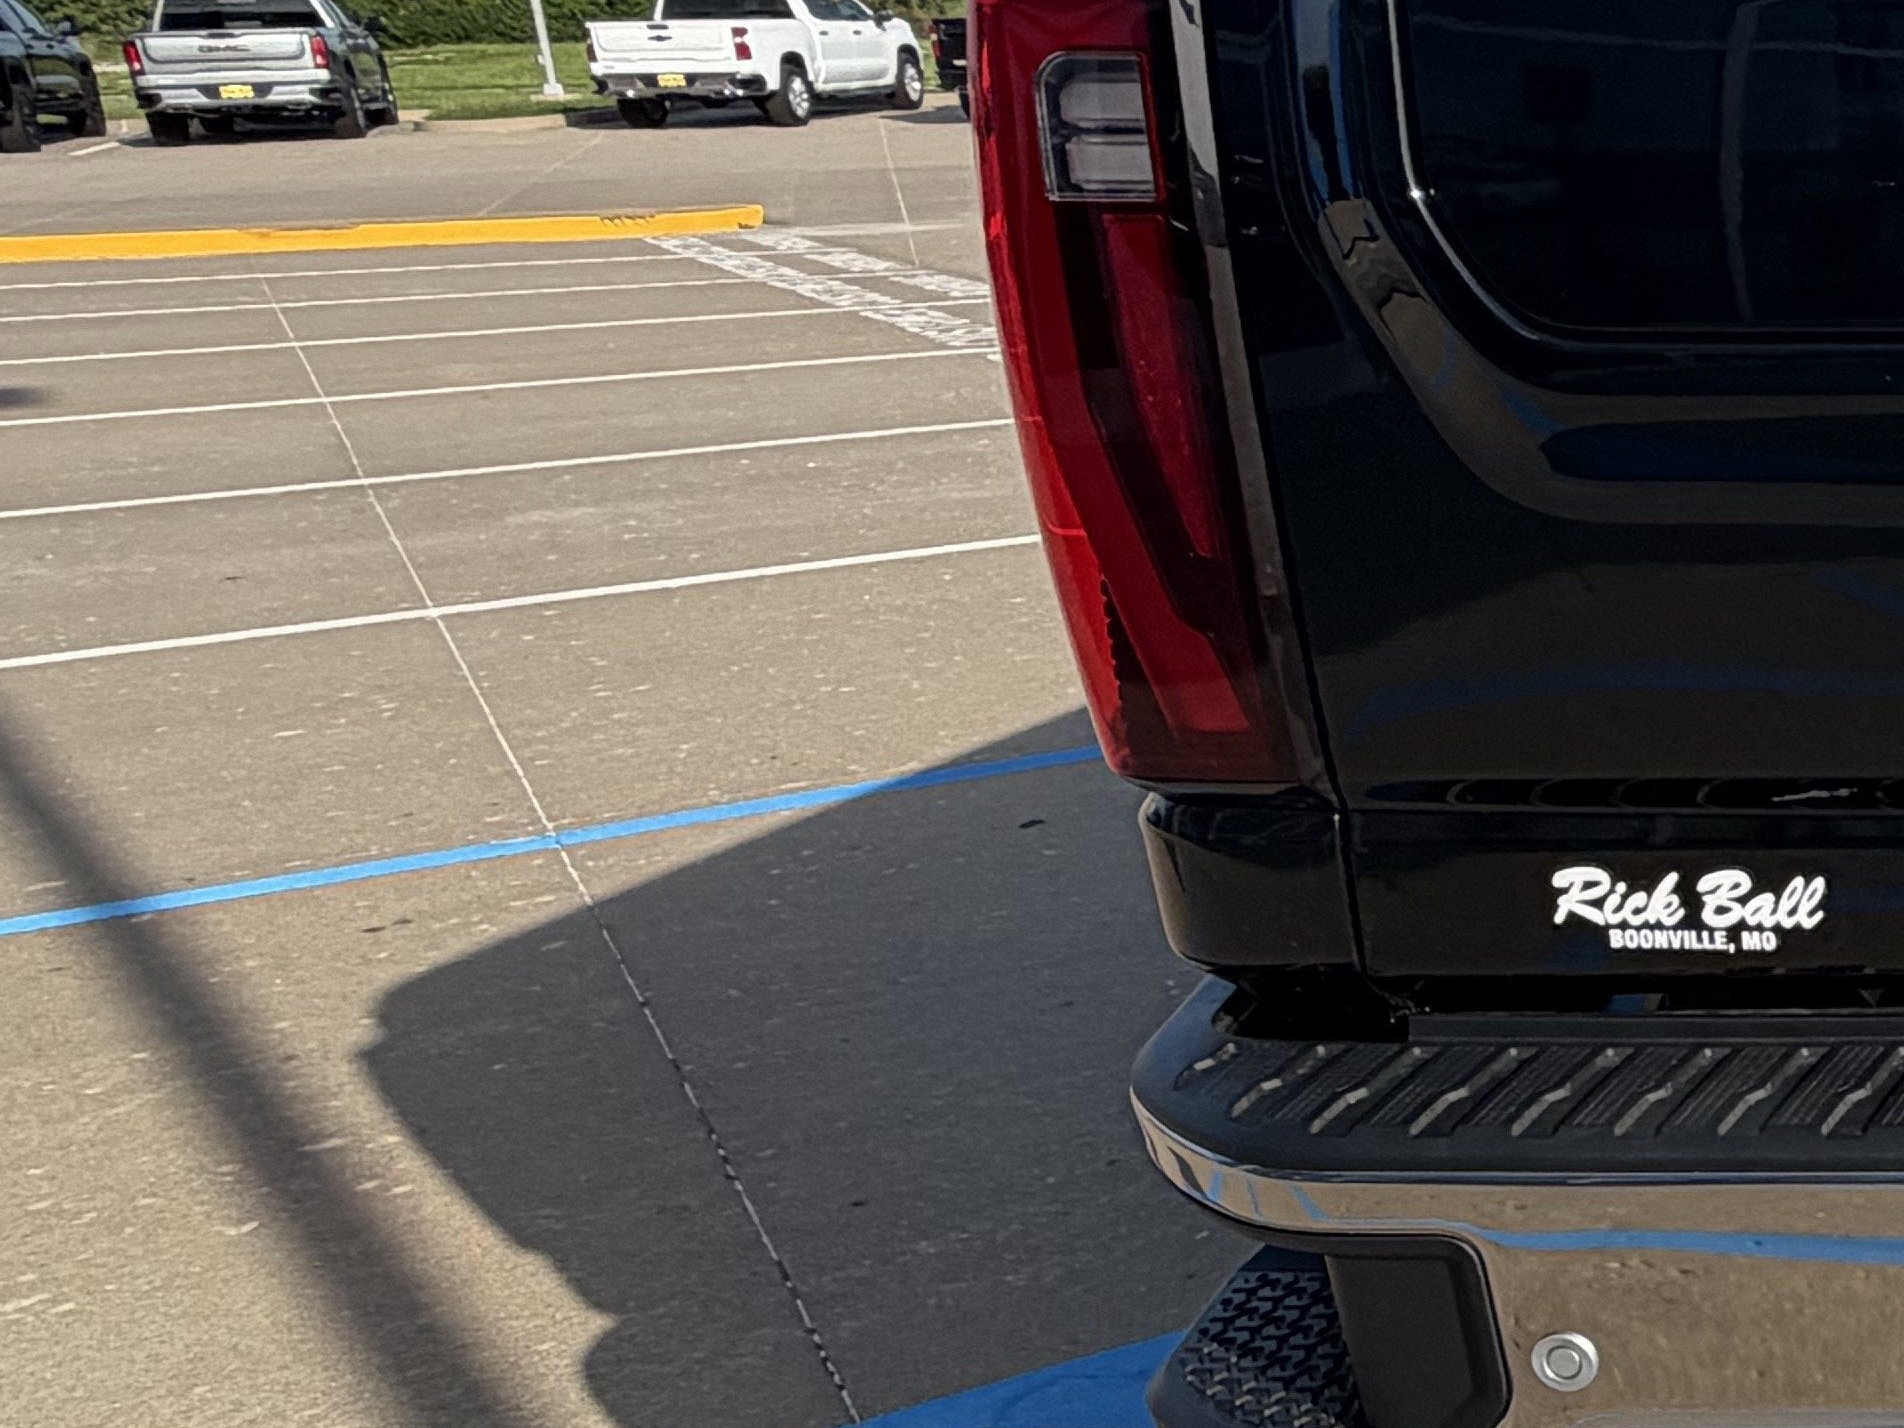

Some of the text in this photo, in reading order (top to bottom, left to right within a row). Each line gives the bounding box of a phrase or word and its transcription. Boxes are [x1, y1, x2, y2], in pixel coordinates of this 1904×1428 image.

[1551, 866, 1827, 930] Rick Ball
[1608, 928, 1778, 954] BOONVILLE, MO
